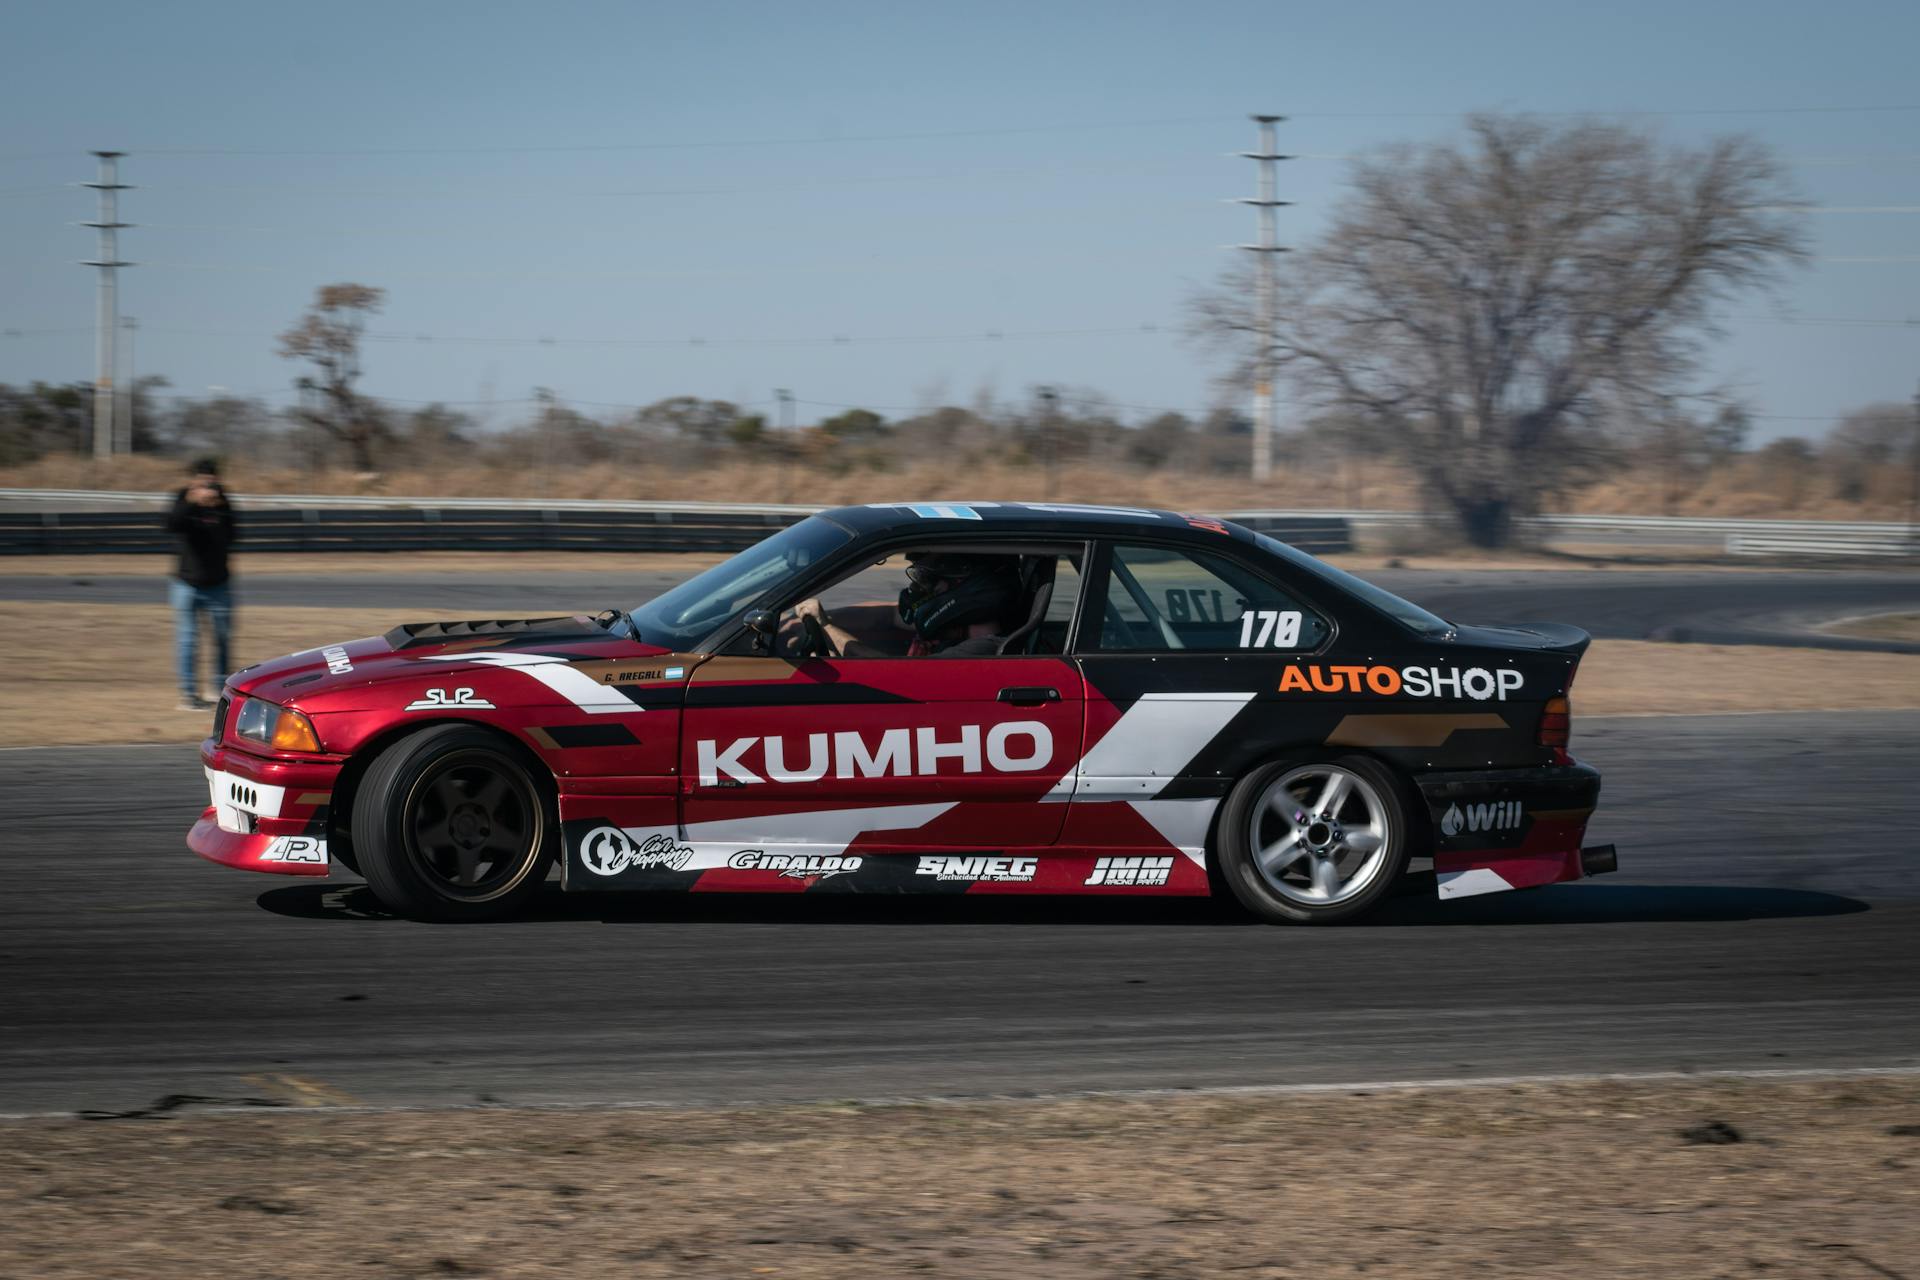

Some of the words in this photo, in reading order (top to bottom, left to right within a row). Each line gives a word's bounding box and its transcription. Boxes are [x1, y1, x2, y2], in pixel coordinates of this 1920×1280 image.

[1239, 610, 1303, 648] 170
[604, 673, 614, 682] G.
[1278, 665, 1524, 701] AUTOSHOP
[697, 720, 1054, 787] KUMHO
[1466, 801, 1522, 832] Will
[640, 834, 674, 855] Car
[612, 848, 694, 871] Wrapping
[915, 856, 1038, 876] SNIEG
[1084, 856, 1175, 885] JMM
[936, 873, 978, 882] Electricidad
[979, 873, 991, 881] del
